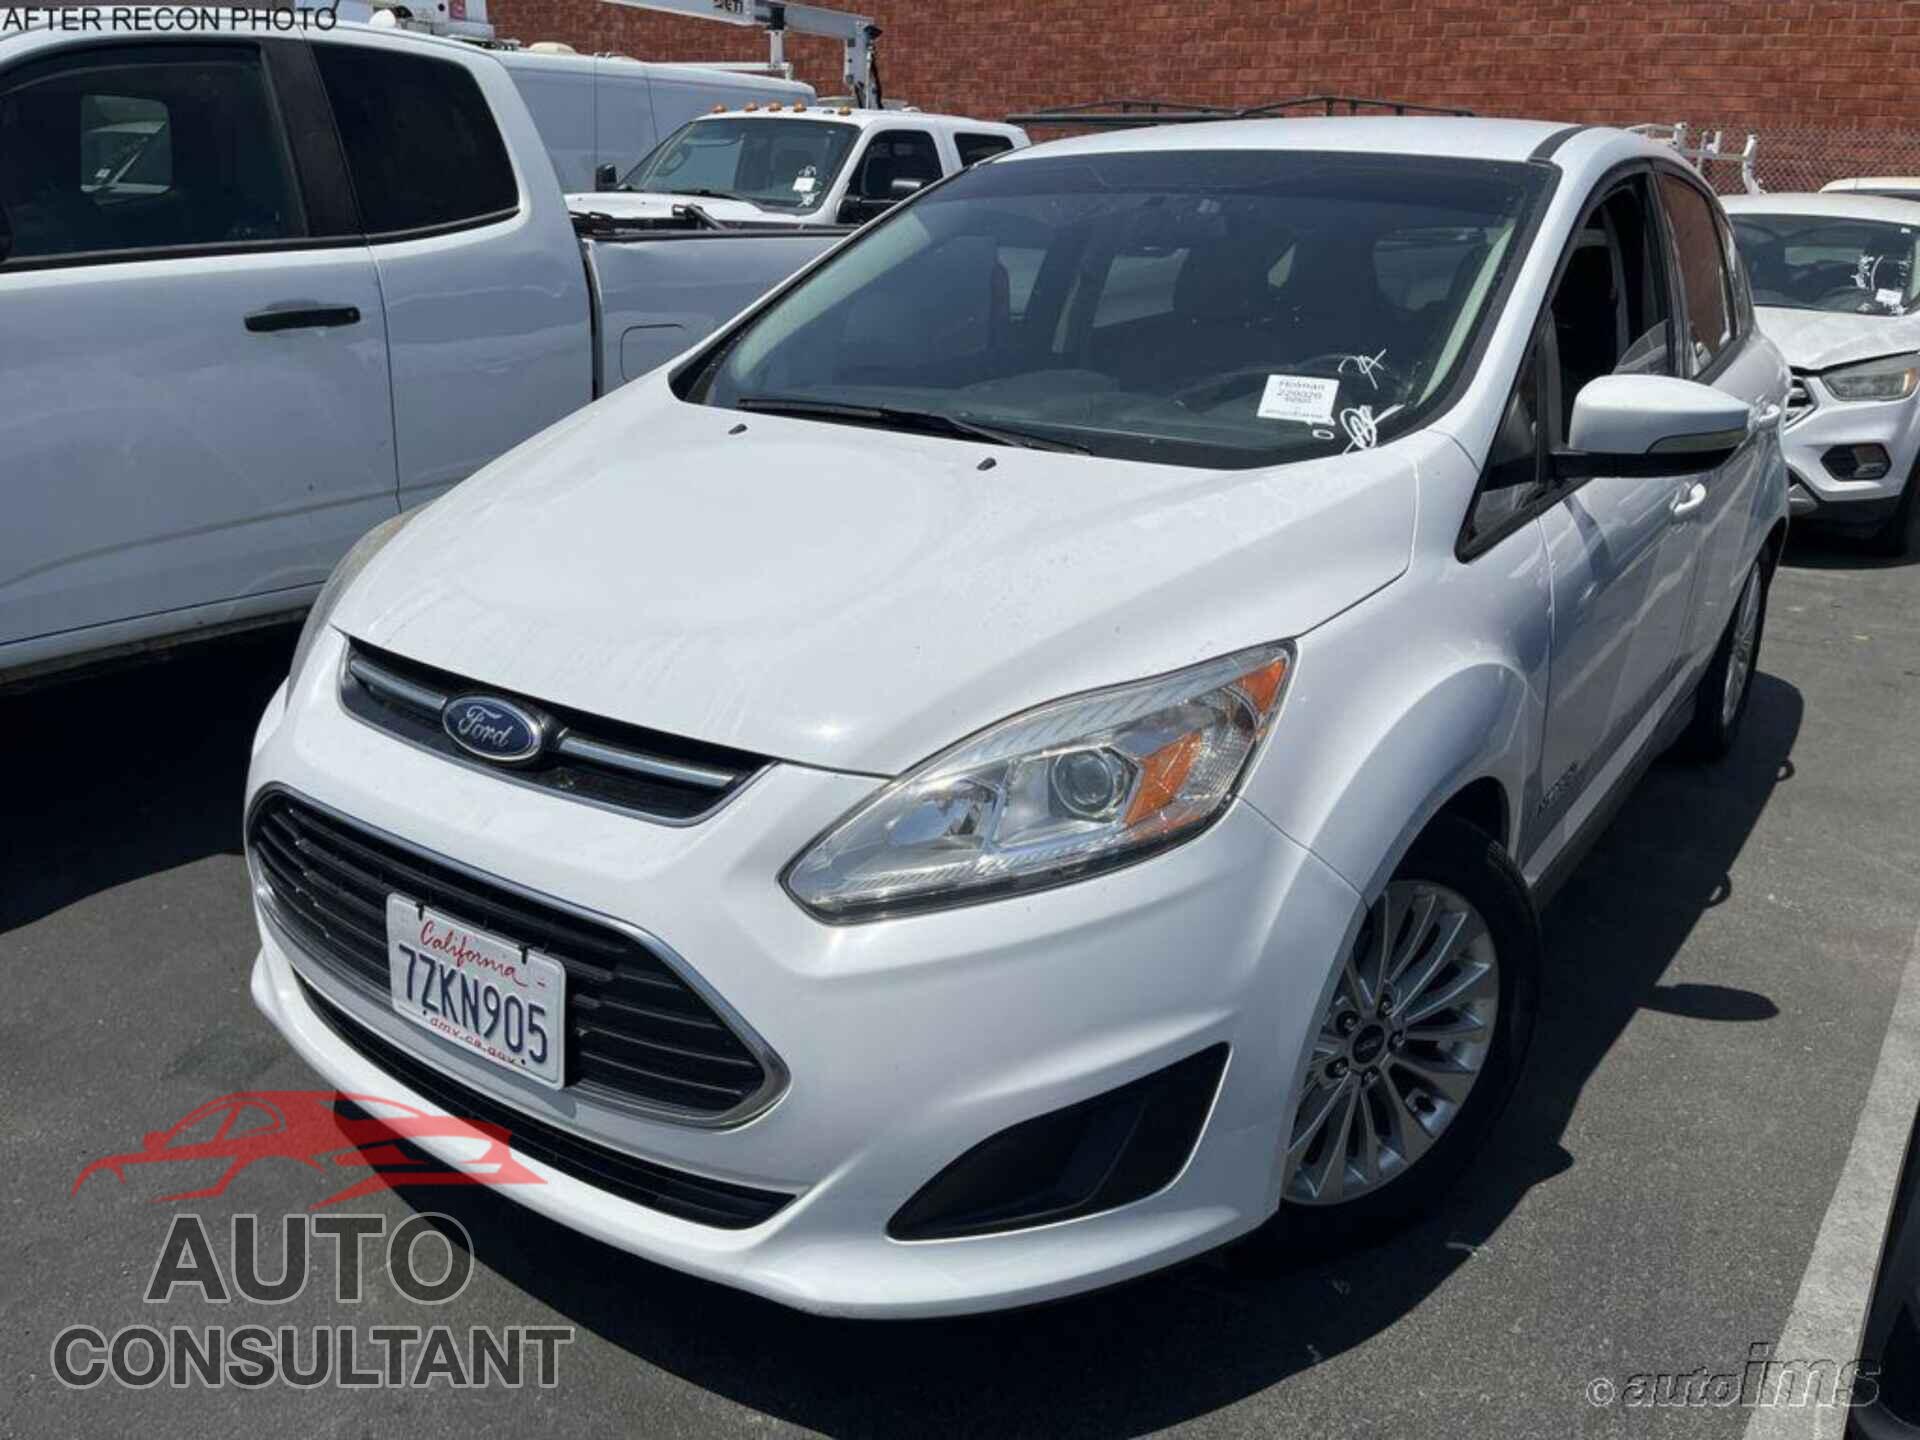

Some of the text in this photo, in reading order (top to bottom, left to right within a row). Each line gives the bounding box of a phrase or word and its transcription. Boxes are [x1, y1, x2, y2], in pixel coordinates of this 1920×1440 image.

[457, 705, 513, 747] Ford
[420, 919, 528, 988] California
[398, 944, 548, 1064] 7ZKN905
